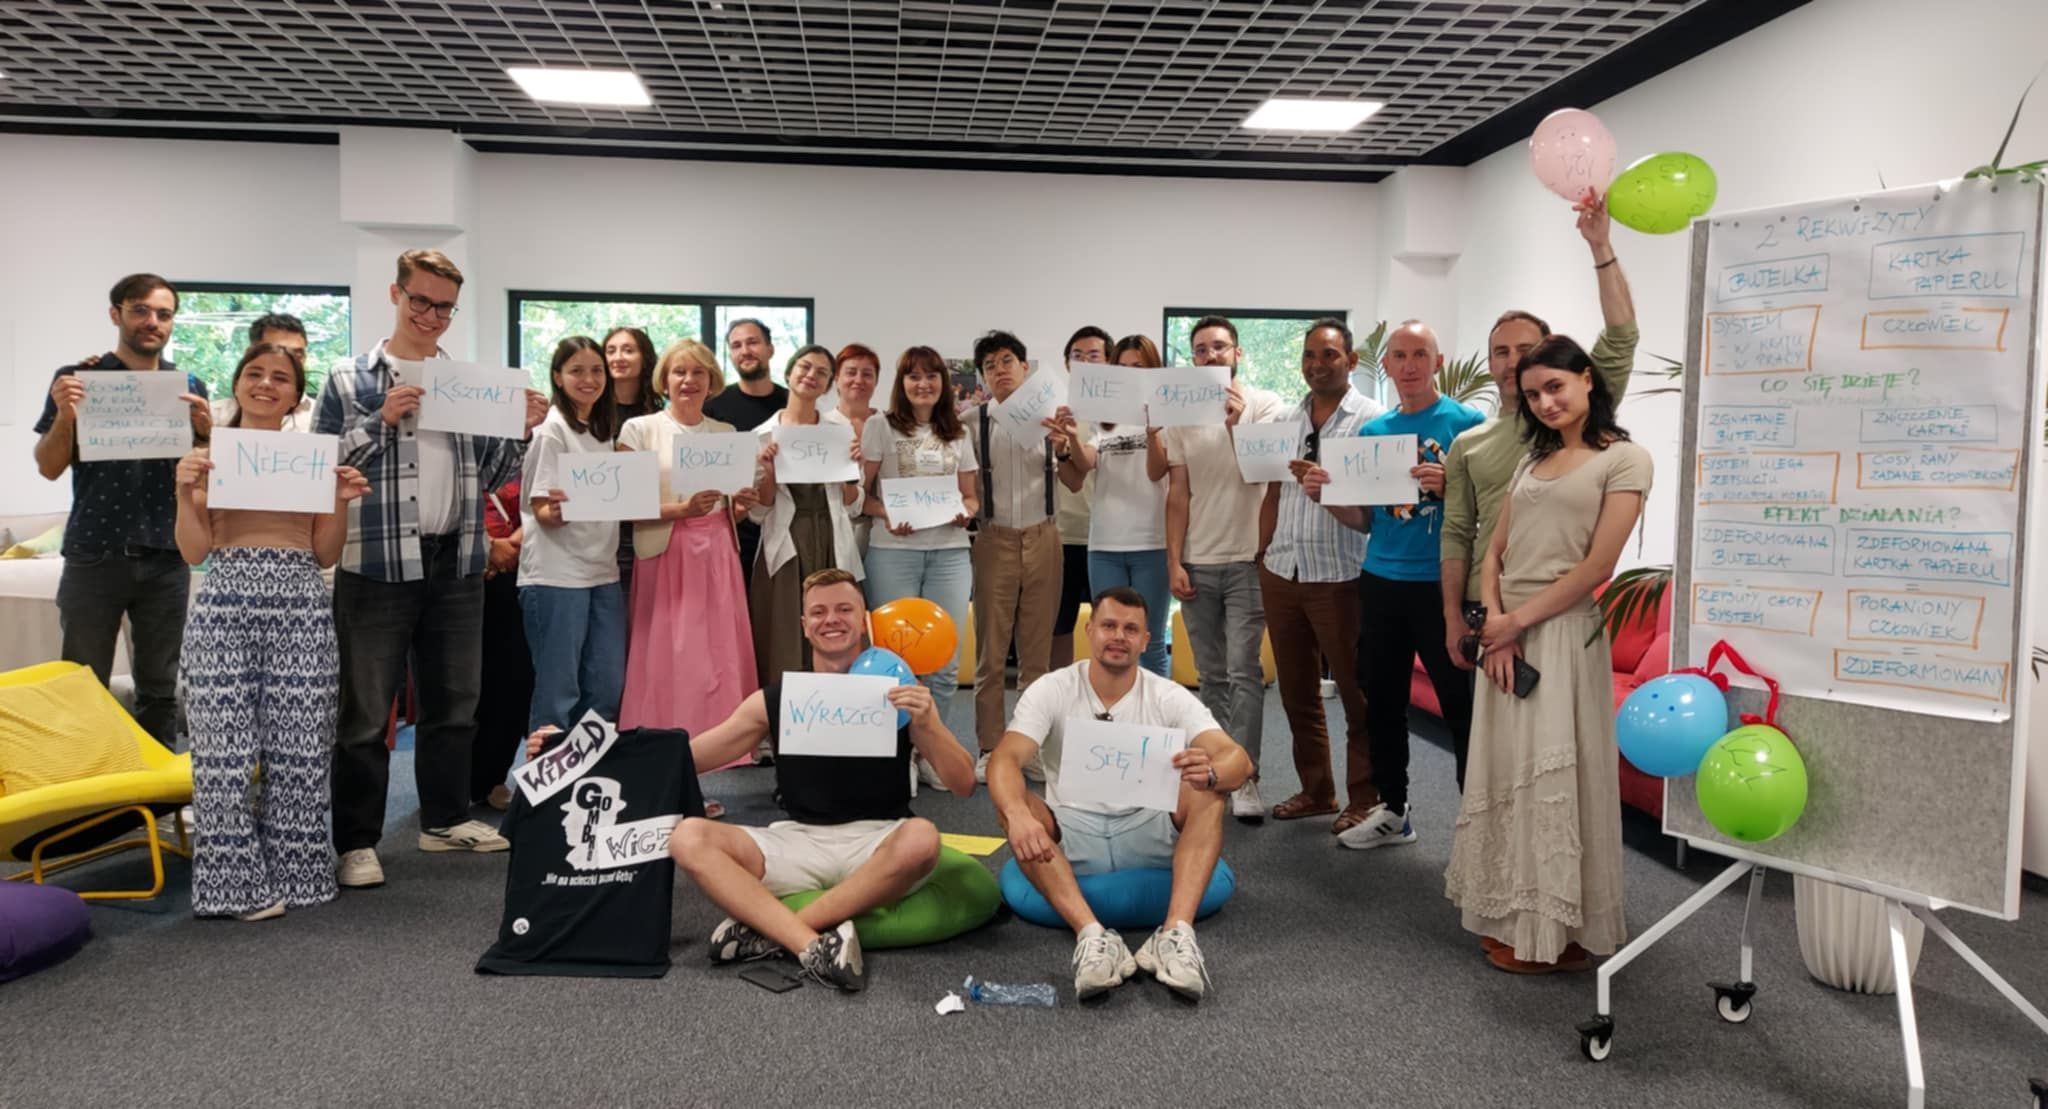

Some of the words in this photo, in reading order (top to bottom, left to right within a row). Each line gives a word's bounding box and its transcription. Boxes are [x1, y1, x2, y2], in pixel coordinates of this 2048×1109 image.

[1756, 224, 1779, 250] 2
[1797, 206, 1936, 242] REKWIZYTY
[1888, 246, 1972, 272] KARTKA
[1728, 264, 1822, 293] BUTELKA
[1911, 271, 2009, 291] PAPIERU
[1712, 312, 1783, 336] SYSTEM
[1881, 318, 1984, 335] CZŁOWIEK
[1756, 351, 1804, 367] PRACY
[432, 375, 525, 405] KSZTAŁT
[1080, 377, 1126, 398] NIE
[1760, 379, 1789, 393] CO
[1803, 373, 1836, 399] SIĘ
[1716, 429, 1780, 443] BUTELKI
[1907, 421, 1971, 437] KARTKI
[679, 443, 737, 469] RODZI
[791, 439, 830, 465] SIĘ
[1920, 452, 1961, 466] RANY
[1702, 458, 1751, 471] SYSTEM
[1760, 458, 1805, 471] ULEGA
[571, 461, 622, 502] MÓJ
[1870, 470, 1924, 482] ZADANE
[887, 493, 909, 508] ZE
[1702, 527, 1830, 549] ZDEFORMOWANA
[1857, 536, 1992, 555] ZDEFORMOWANA
[1712, 549, 1791, 568] BUTELKA
[1854, 556, 1912, 570] KARTKA
[1918, 557, 2001, 581] PAPIERU
[1697, 588, 1760, 603] ZEPSUTY
[1855, 594, 1963, 617] PORANIONY
[1707, 607, 1764, 625] SYSTEM
[1868, 619, 1969, 642] CZŁOWIEK
[1842, 656, 2006, 686] ZDEFORMOWANY
